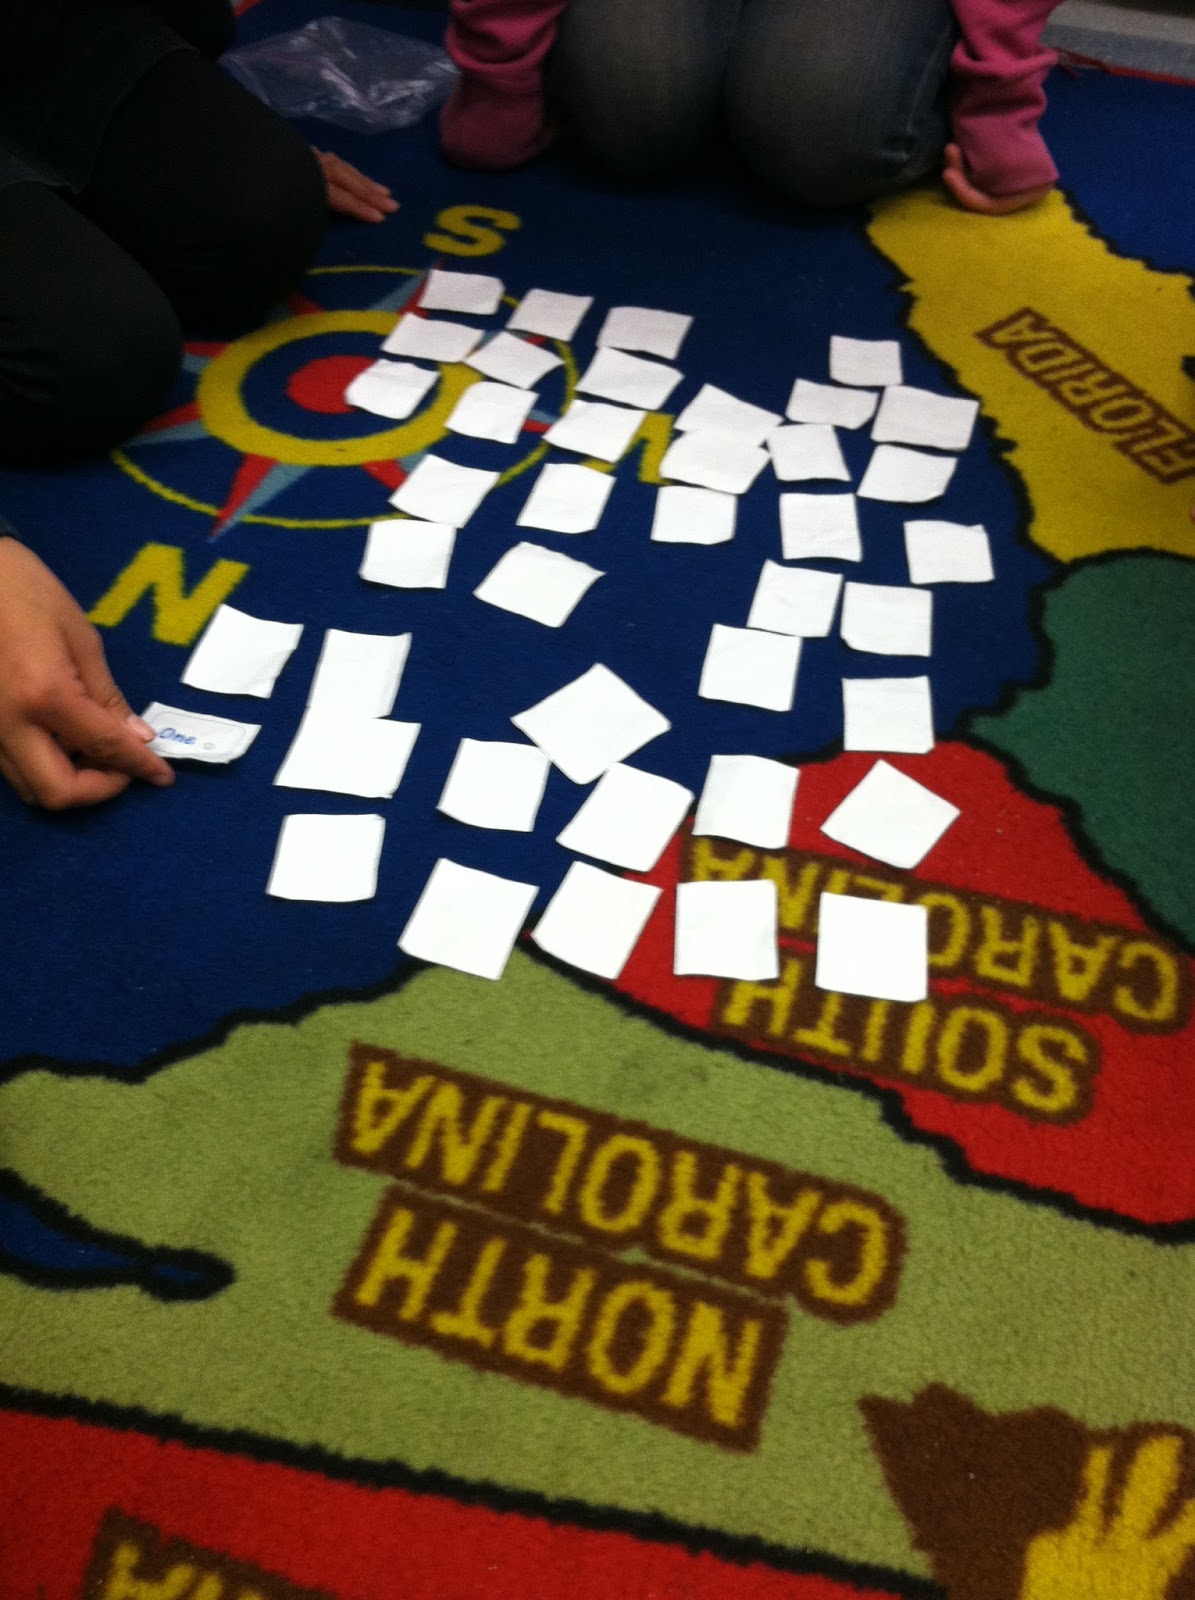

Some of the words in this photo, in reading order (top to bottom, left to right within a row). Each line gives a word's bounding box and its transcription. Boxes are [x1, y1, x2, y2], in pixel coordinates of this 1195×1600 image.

[422, 204, 522, 257] S
[986, 313, 1195, 476] FLORIDA
[86, 541, 251, 646] N
[693, 837, 1180, 1023] CARONA
[350, 1060, 889, 1307] CAROLINA
[353, 1205, 763, 1429] NORTH
